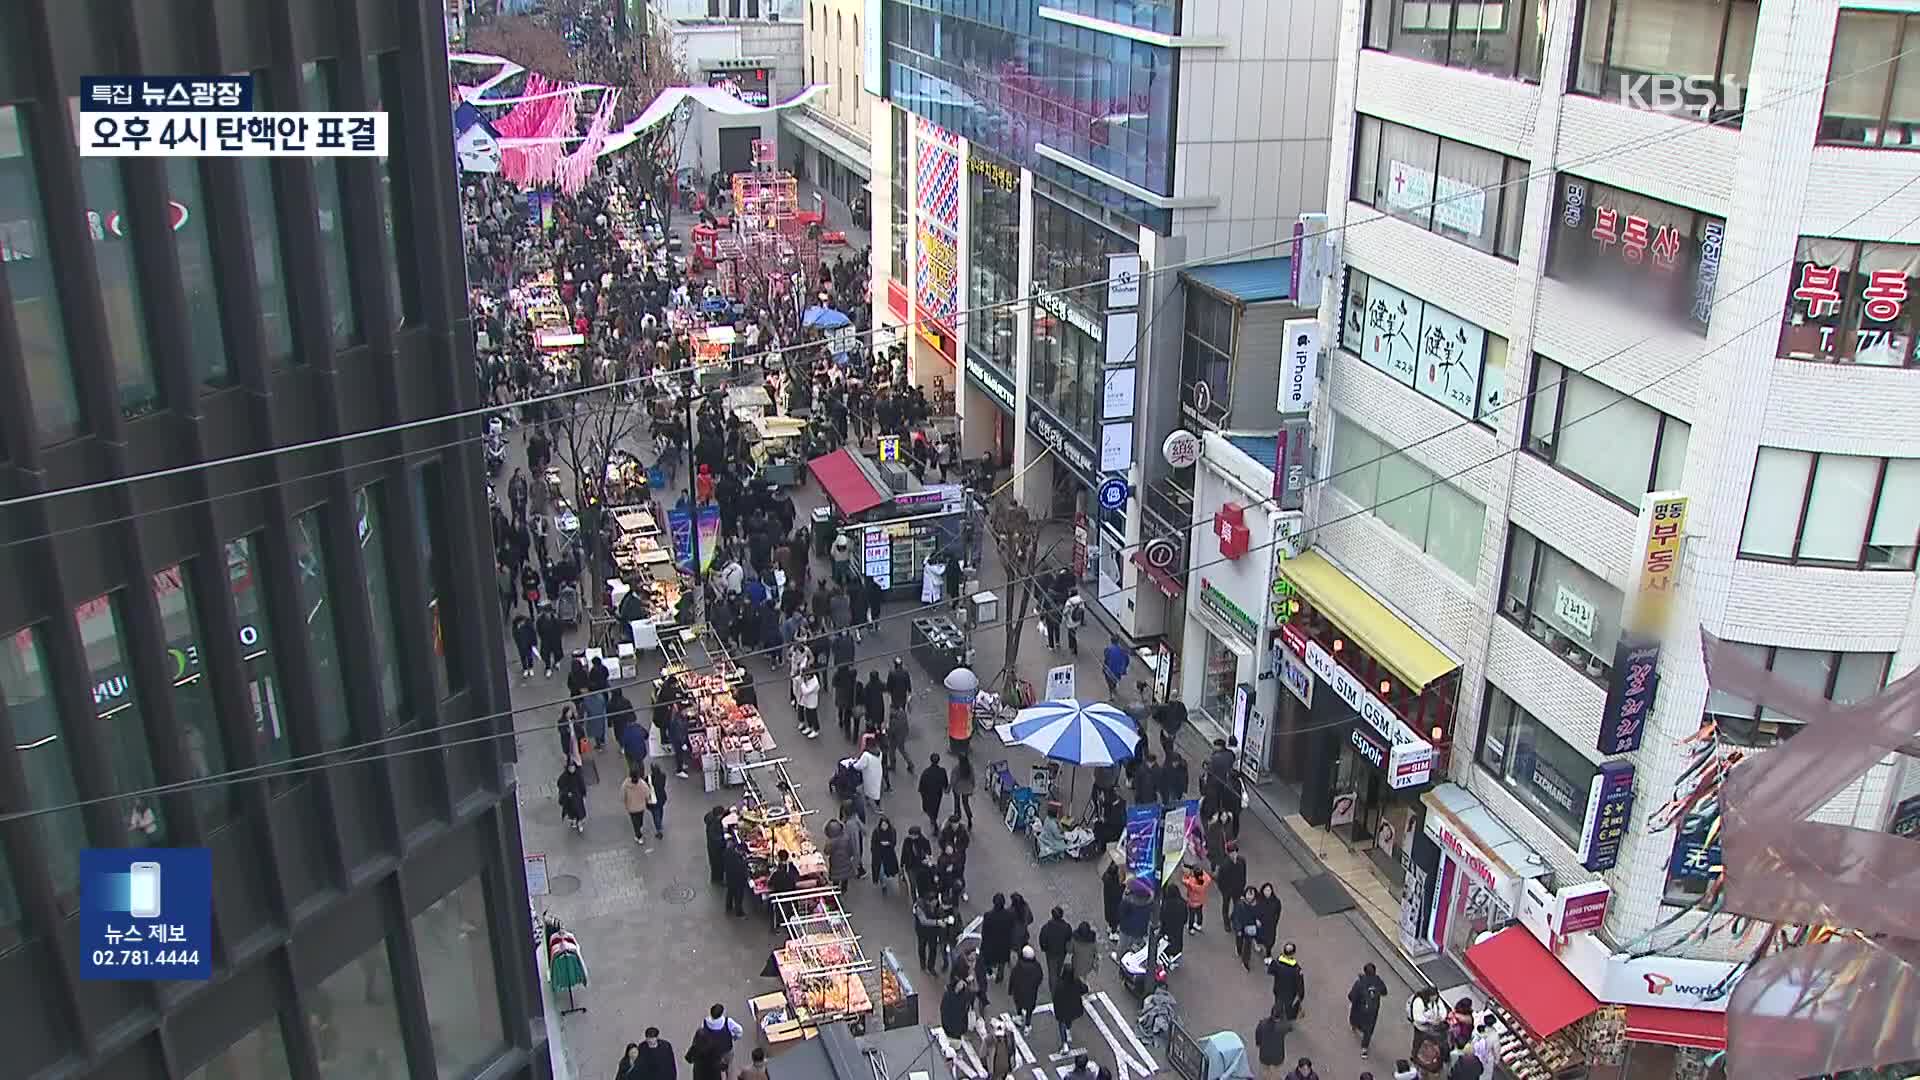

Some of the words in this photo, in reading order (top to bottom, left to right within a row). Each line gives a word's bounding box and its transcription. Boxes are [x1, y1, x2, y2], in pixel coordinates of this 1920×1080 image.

[1592, 206, 1681, 274] 부동산
[1292, 350, 1309, 402] iPhone
[1654, 502, 1683, 520] 명동
[1337, 677, 1357, 705] SIM
[1364, 704, 1390, 739] GSM
[1351, 733, 1383, 767] espoir
[1411, 761, 1430, 772] SIM
[1396, 776, 1412, 786] FIX
[1533, 769, 1573, 811] EXCHANGE
[1439, 826, 1463, 856] LENS
[1465, 851, 1497, 889] TOWN
